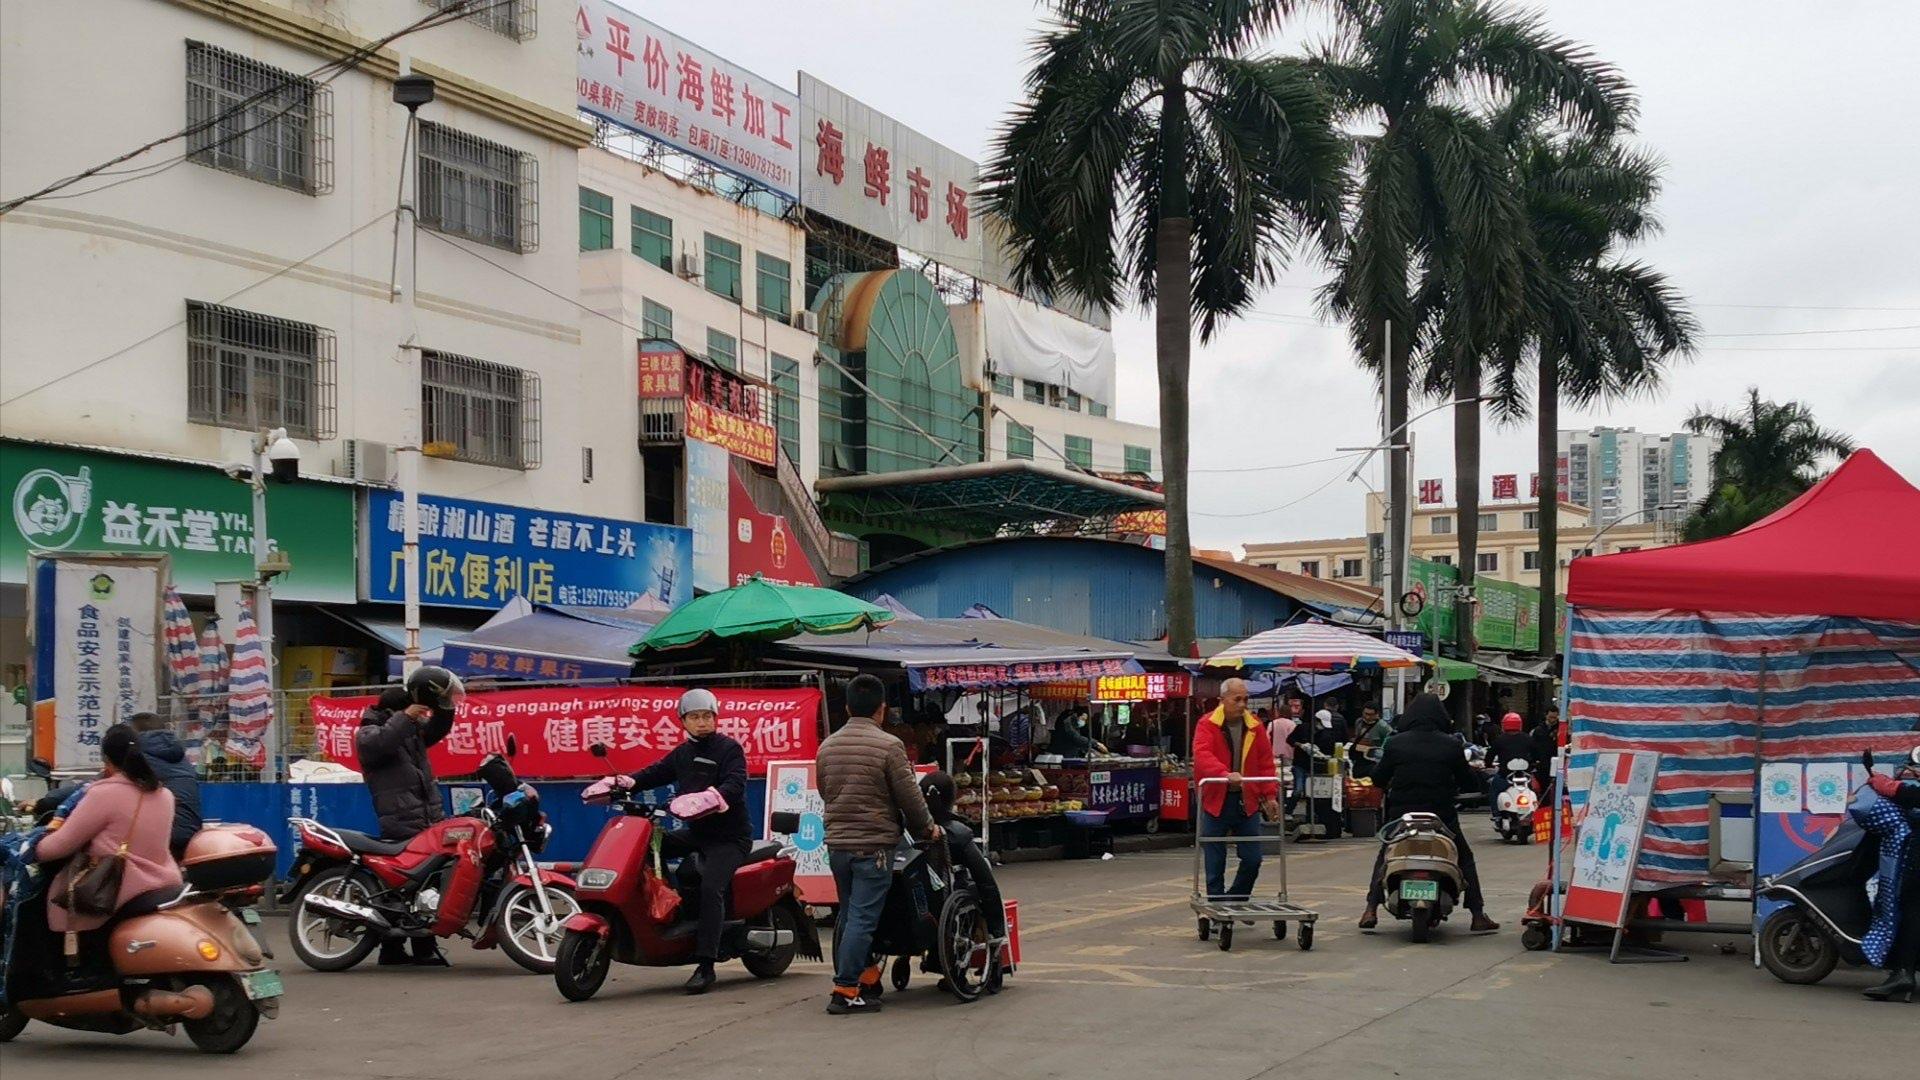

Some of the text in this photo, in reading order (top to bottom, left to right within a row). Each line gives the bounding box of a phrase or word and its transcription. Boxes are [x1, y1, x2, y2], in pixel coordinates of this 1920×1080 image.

[606, 16, 792, 150] 平价海鲜加工
[634, 100, 679, 138] 宽敞明亮
[816, 118, 968, 240] 海鲜市场
[103, 500, 219, 552] 益禾堂
[221, 511, 253, 531] YH.
[528, 517, 637, 559] 老酒不上头
[78, 604, 101, 746] 食品安全示范市场
[496, 698, 583, 717] gengangh
[588, 697, 649, 712] mwngz
[725, 700, 800, 711] ancienz.
